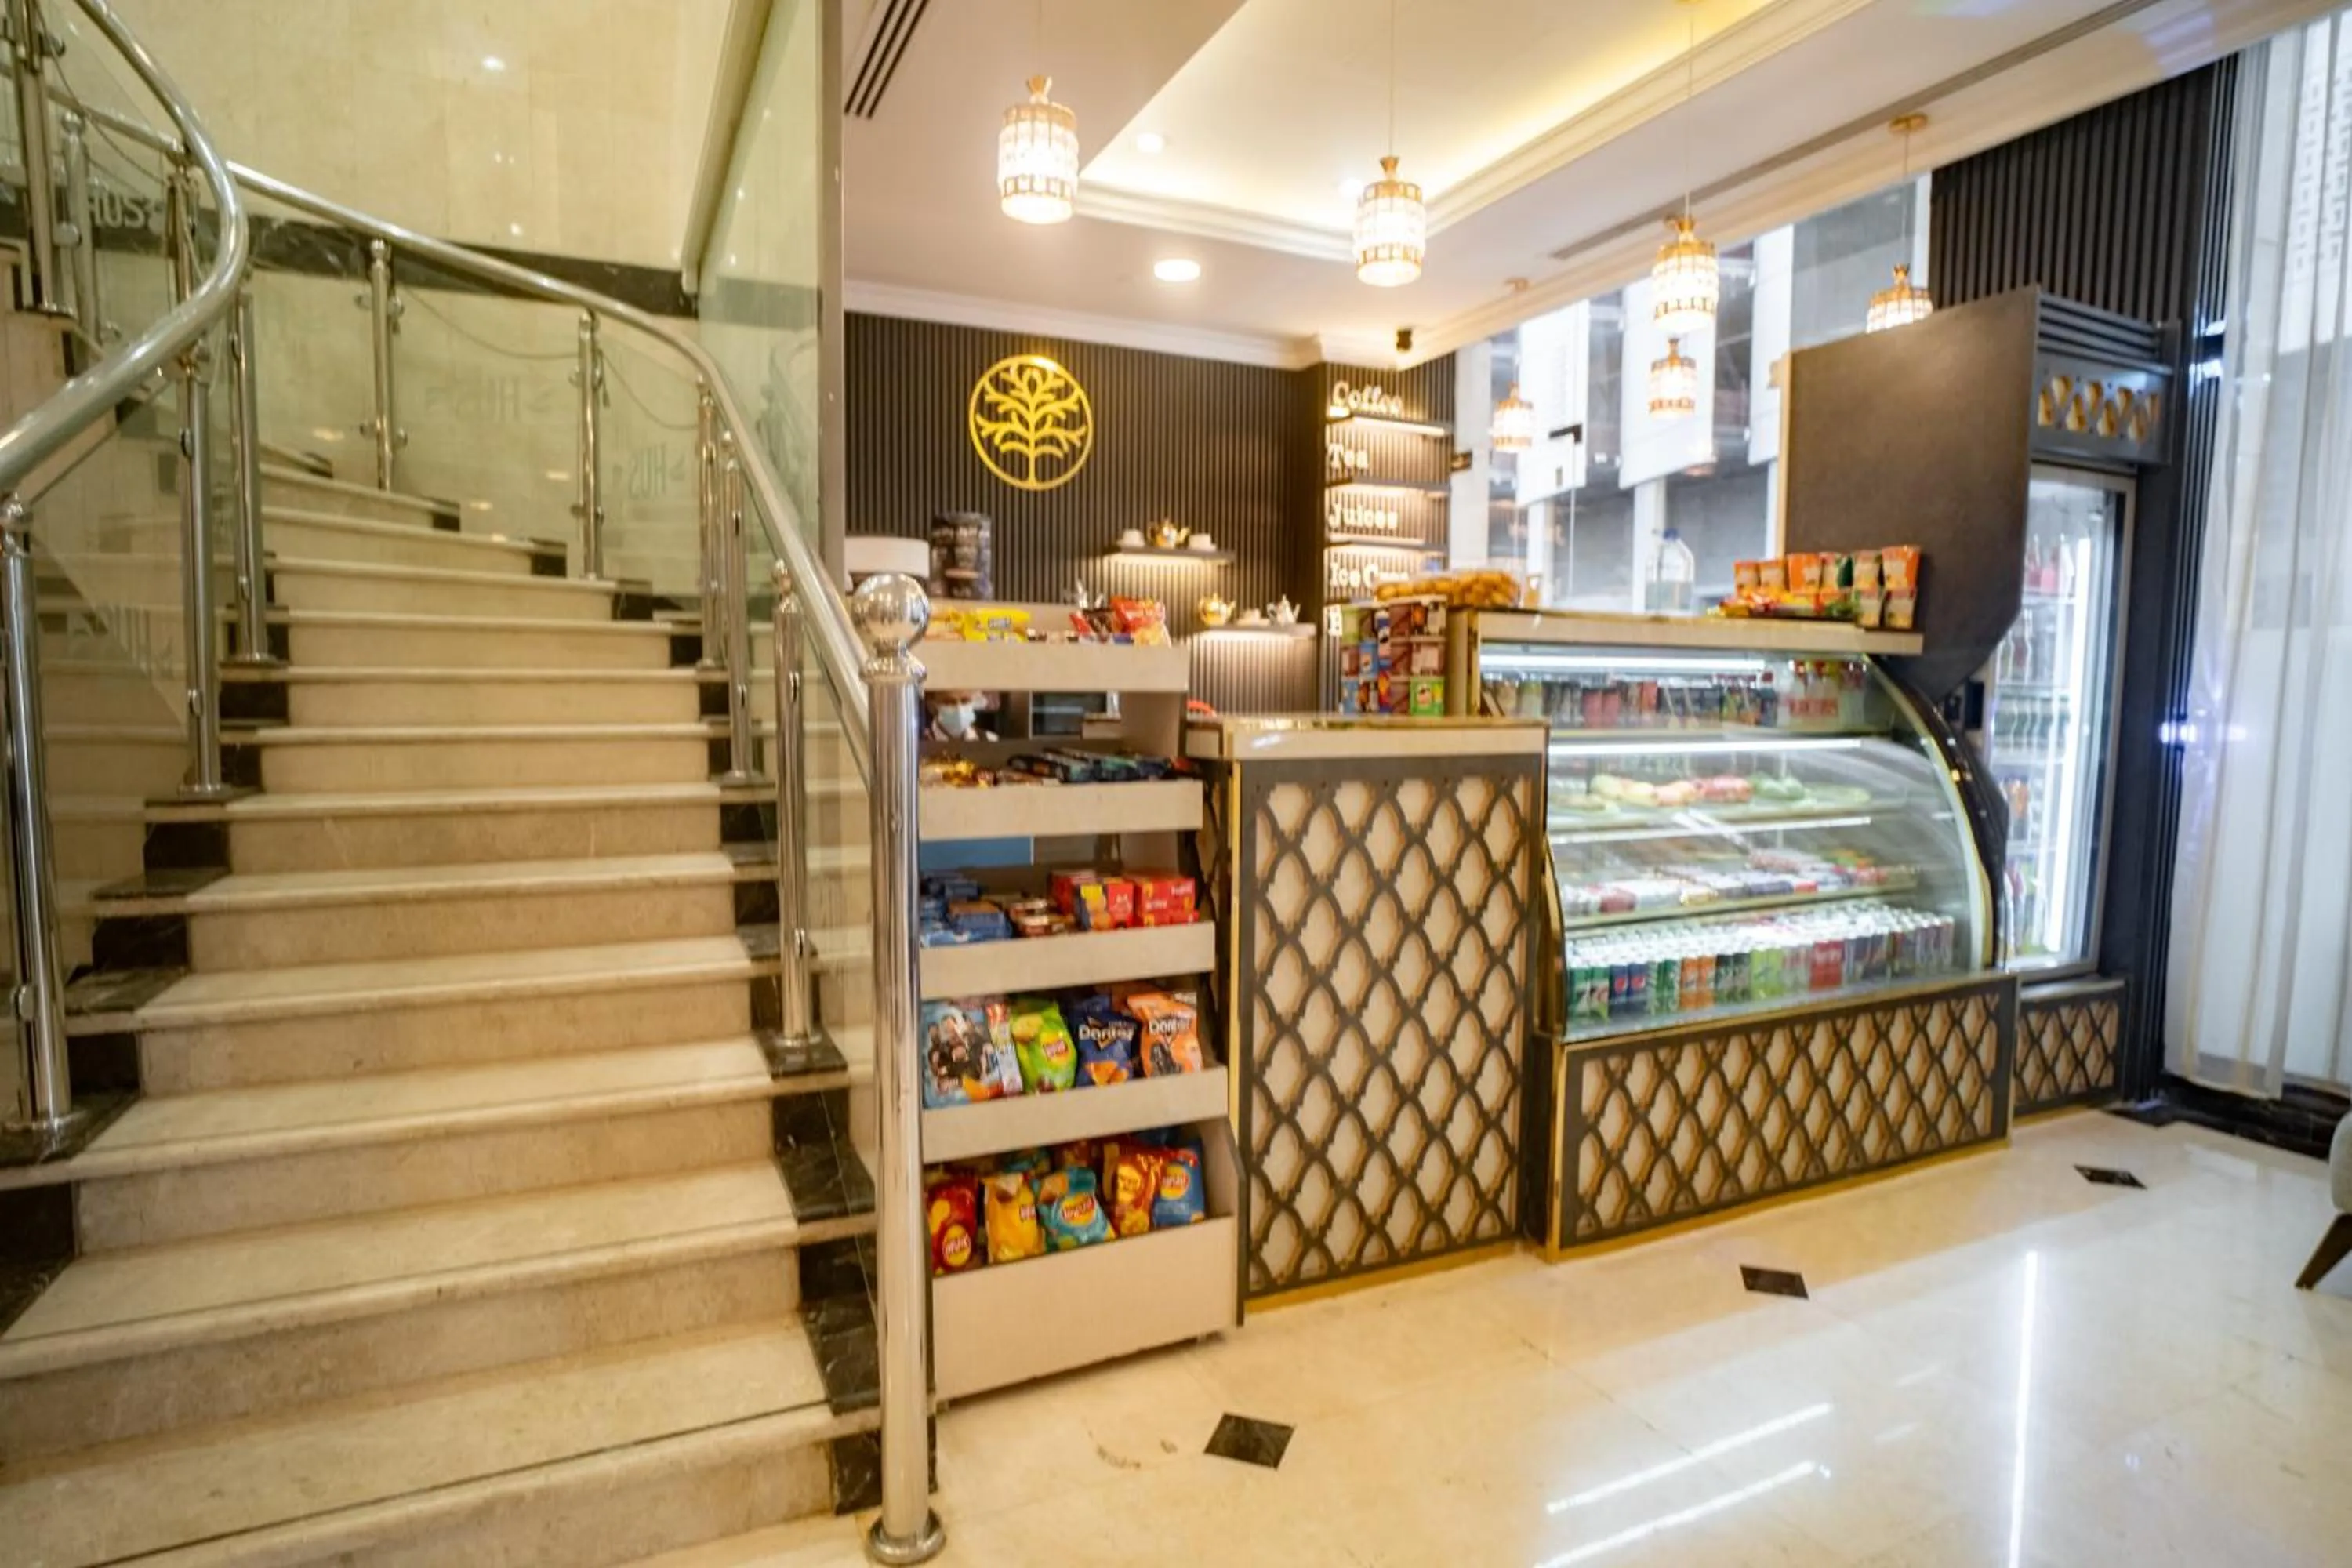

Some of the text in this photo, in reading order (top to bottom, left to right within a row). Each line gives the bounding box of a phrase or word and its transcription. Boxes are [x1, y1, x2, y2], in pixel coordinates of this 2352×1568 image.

[1333, 379, 1404, 417] Coffee
[1328, 442, 1369, 470] Tea
[1328, 503, 1399, 529] Juices
[1329, 562, 1362, 588] Ice
